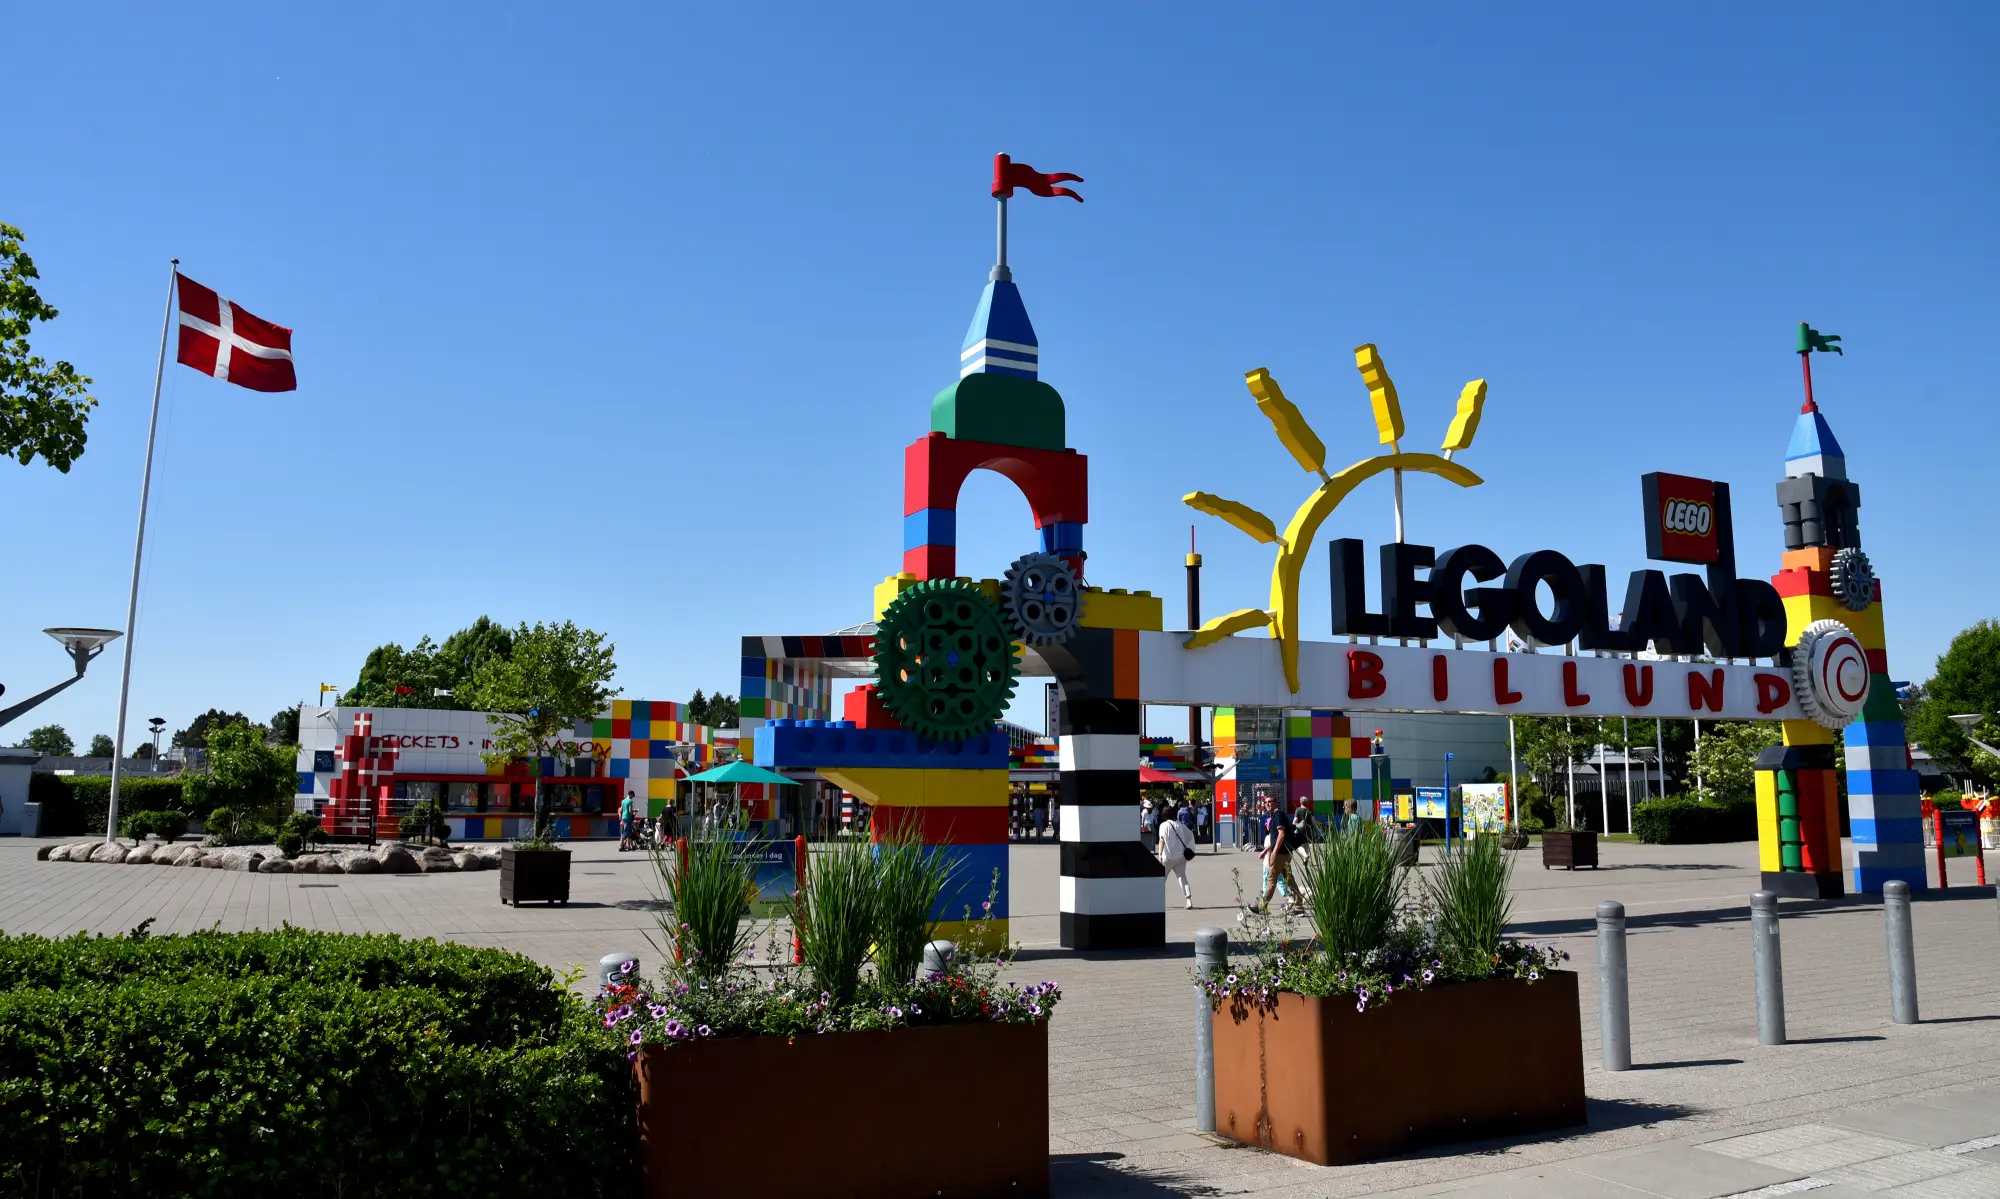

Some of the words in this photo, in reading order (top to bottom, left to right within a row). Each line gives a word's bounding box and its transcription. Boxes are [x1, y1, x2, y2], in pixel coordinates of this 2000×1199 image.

[1665, 500, 1710, 534] LEGO
[1329, 538, 1788, 658] LEGOLAND
[1346, 650, 1791, 715] BILLUND
